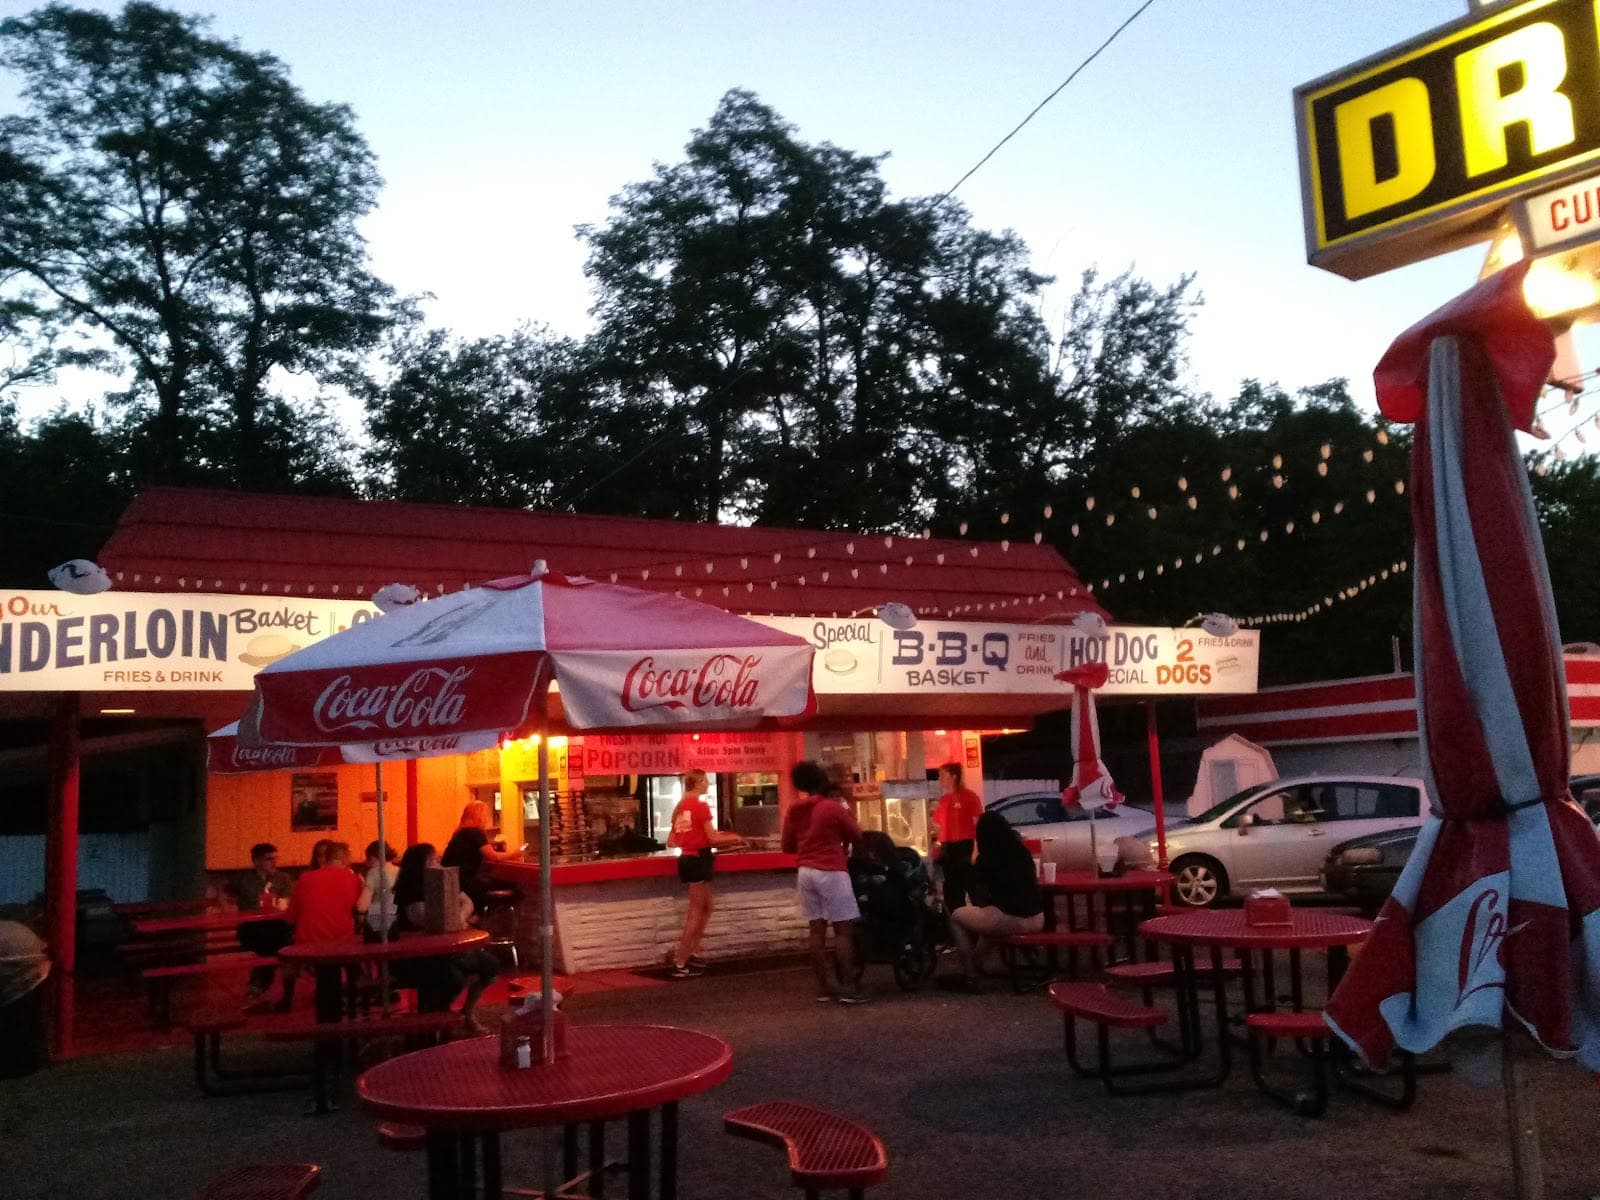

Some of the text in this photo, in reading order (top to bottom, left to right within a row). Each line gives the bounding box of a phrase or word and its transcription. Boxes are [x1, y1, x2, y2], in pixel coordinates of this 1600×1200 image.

[1334, 0, 1600, 220] DR
[1550, 187, 1600, 231] CU
[8, 596, 70, 616] Our
[229, 606, 321, 635] Basket
[813, 621, 877, 650] Special
[1018, 632, 1056, 644] FRIES
[1198, 638, 1224, 648] FRIES
[1231, 638, 1254, 649] DRINK
[1024, 645, 1049, 663] and
[1070, 632, 1159, 668] HOT DOG
[1176, 639, 1195, 662] 2
[103, 671, 224, 683] FRIES & DRINK
[906, 669, 990, 686] BASKET
[1016, 664, 1054, 675] DRINK
[1108, 668, 1149, 685] ECIAL
[1156, 664, 1212, 685] DOGS
[621, 654, 762, 713] Coca-Cola
[313, 664, 474, 733] Coca-Cola
[587, 747, 681, 769] POPCORN
